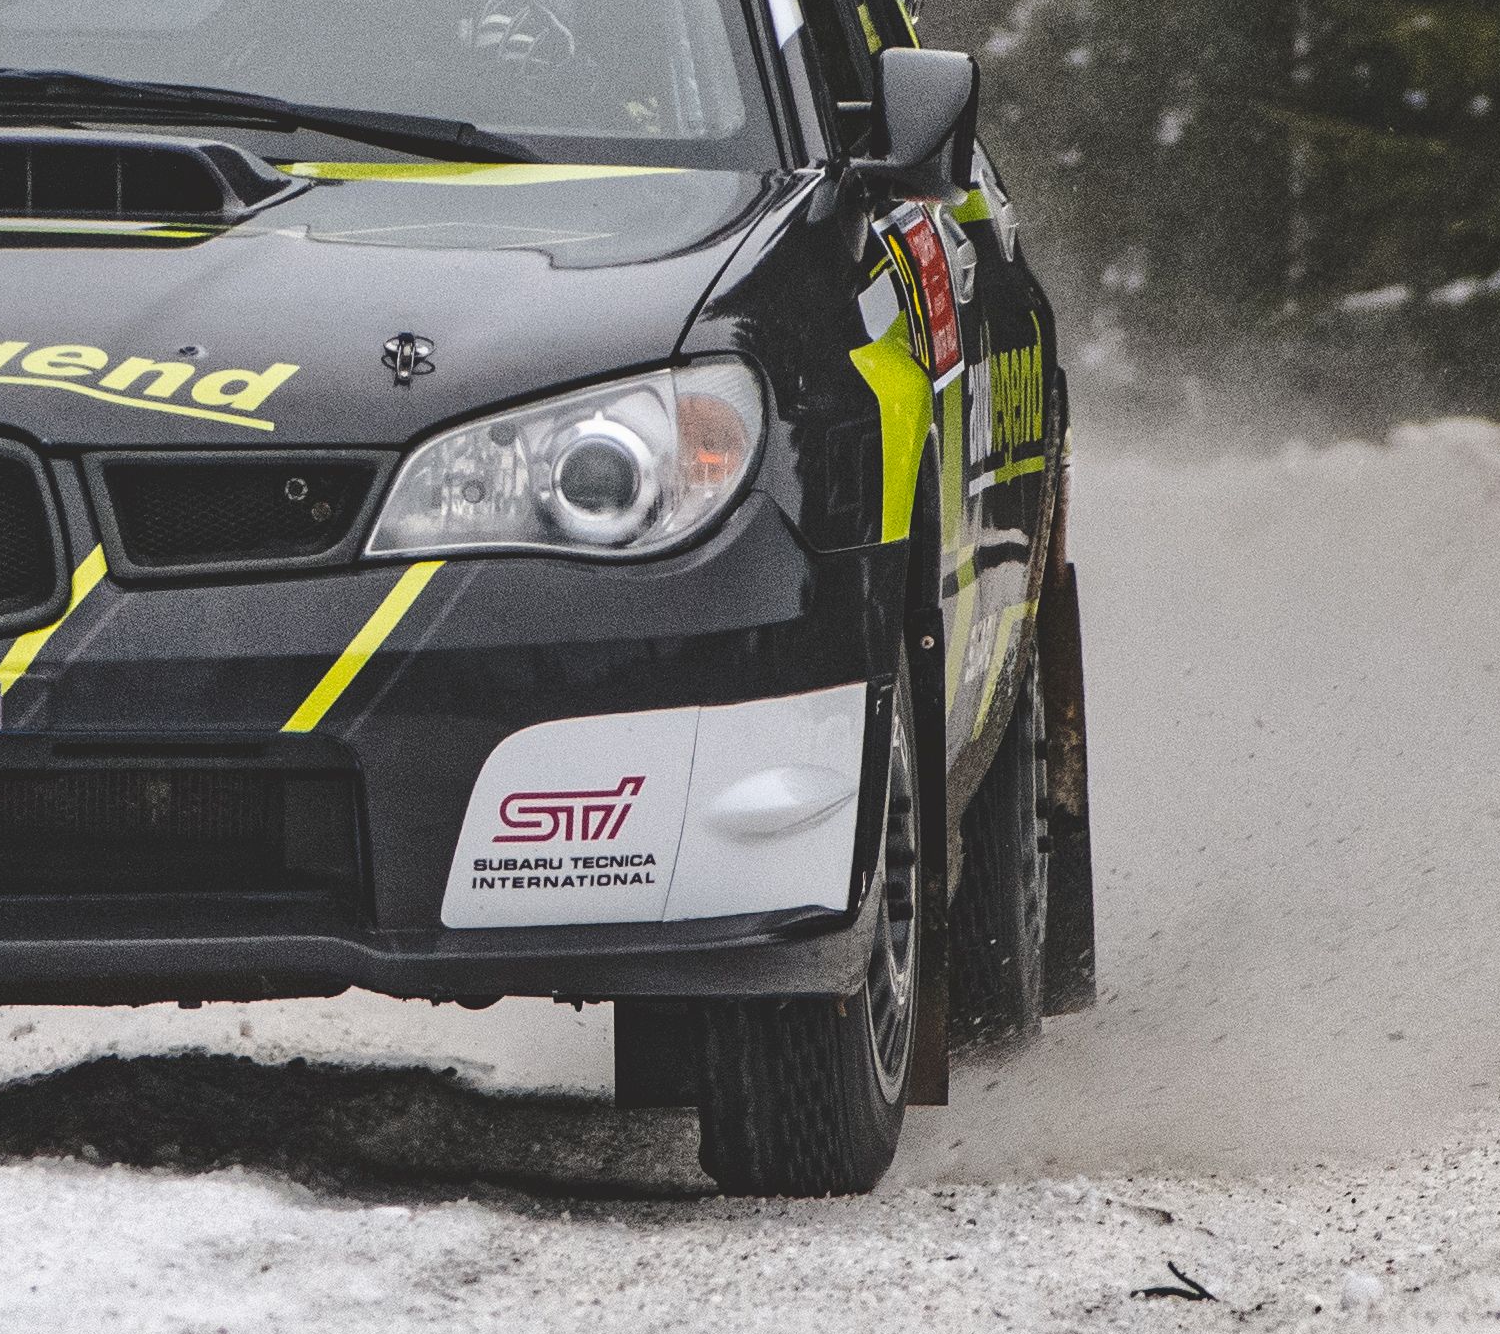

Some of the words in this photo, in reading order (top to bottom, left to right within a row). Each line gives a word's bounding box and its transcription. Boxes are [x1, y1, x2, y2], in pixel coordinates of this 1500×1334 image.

[473, 857, 563, 871] SUBARU
[570, 854, 657, 870] TECNICA
[471, 872, 656, 890] INTERNATIONAL
